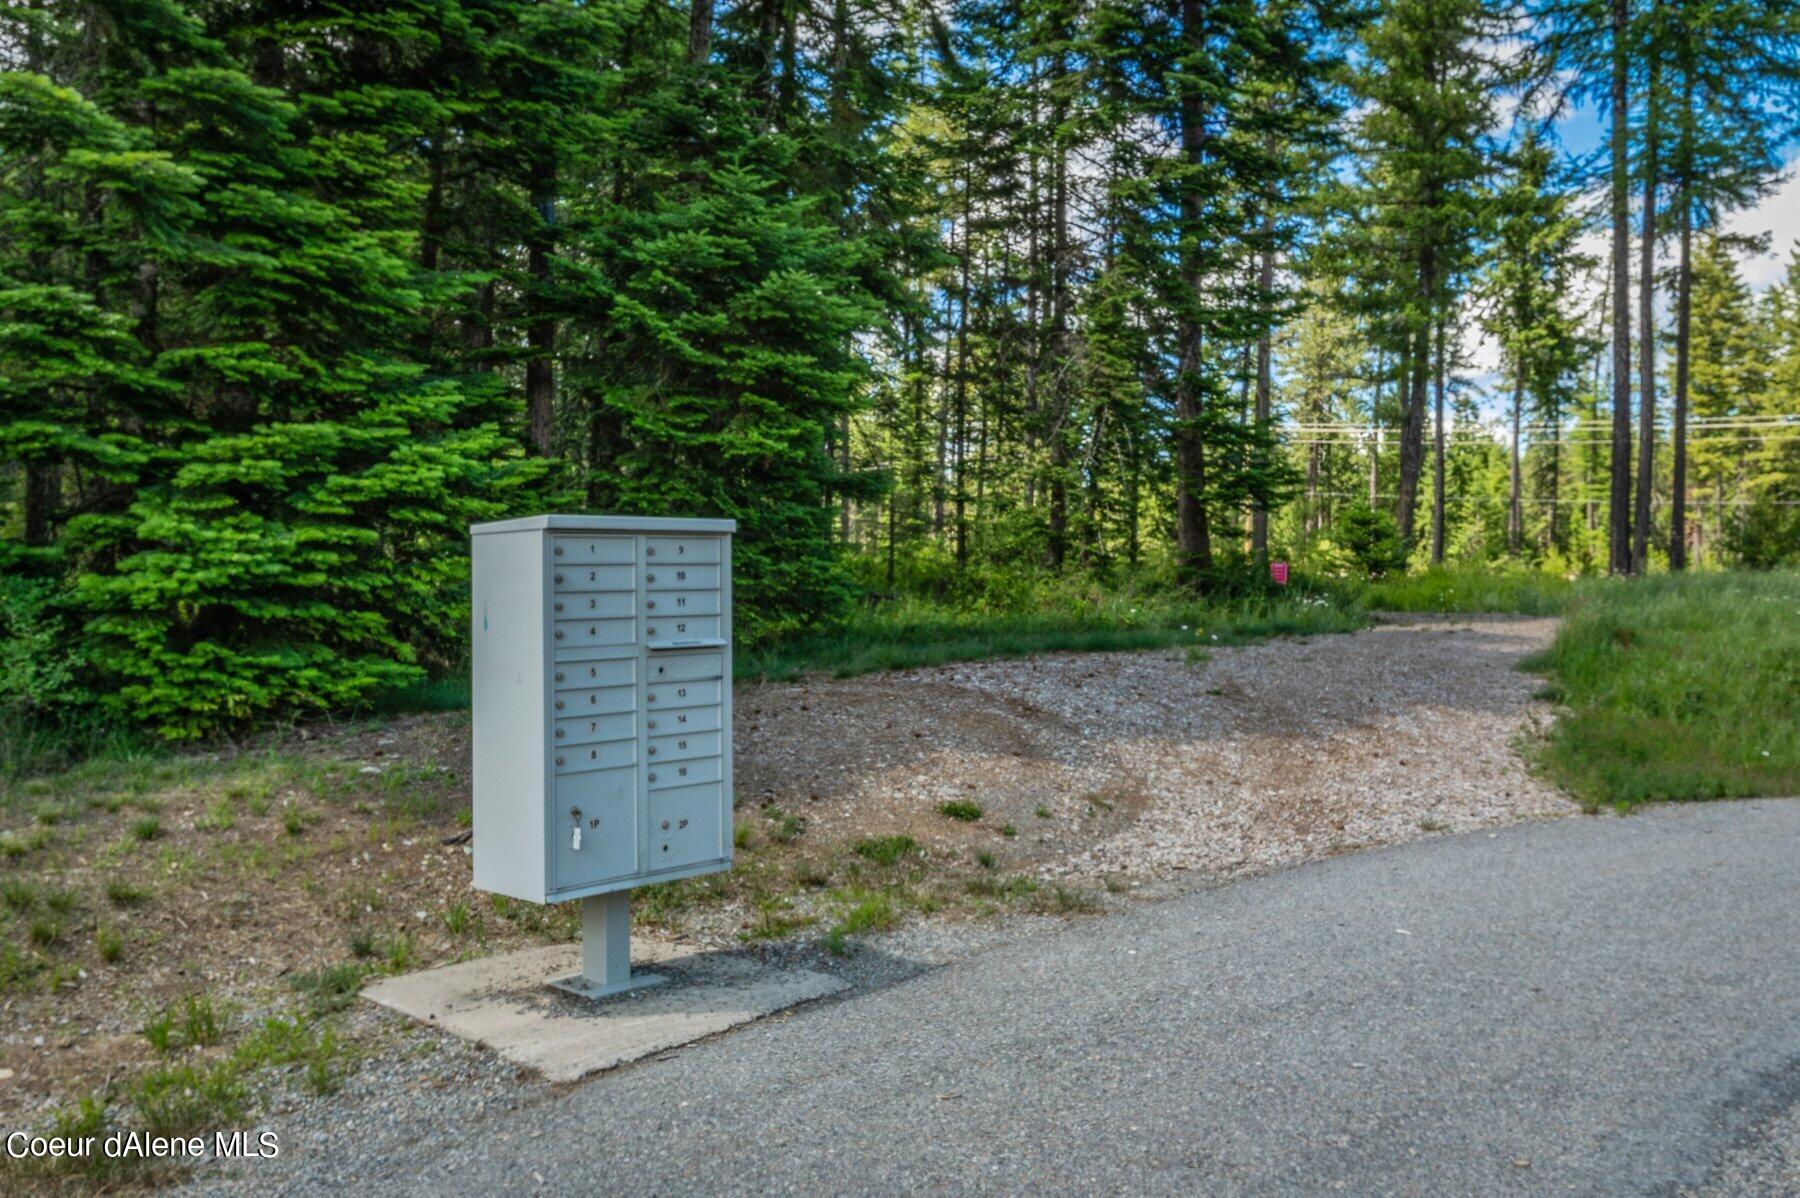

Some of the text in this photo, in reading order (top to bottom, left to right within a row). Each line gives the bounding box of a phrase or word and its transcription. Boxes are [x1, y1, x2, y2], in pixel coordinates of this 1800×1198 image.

[676, 572, 686, 580] 10
[676, 598, 686, 607] 11
[676, 624, 686, 633] 12
[677, 689, 687, 697] 13
[677, 716, 687, 724] 14
[678, 741, 688, 750] 15
[678, 768, 688, 777] 16
[589, 819, 600, 829] 1P
[678, 820, 689, 830] 2P
